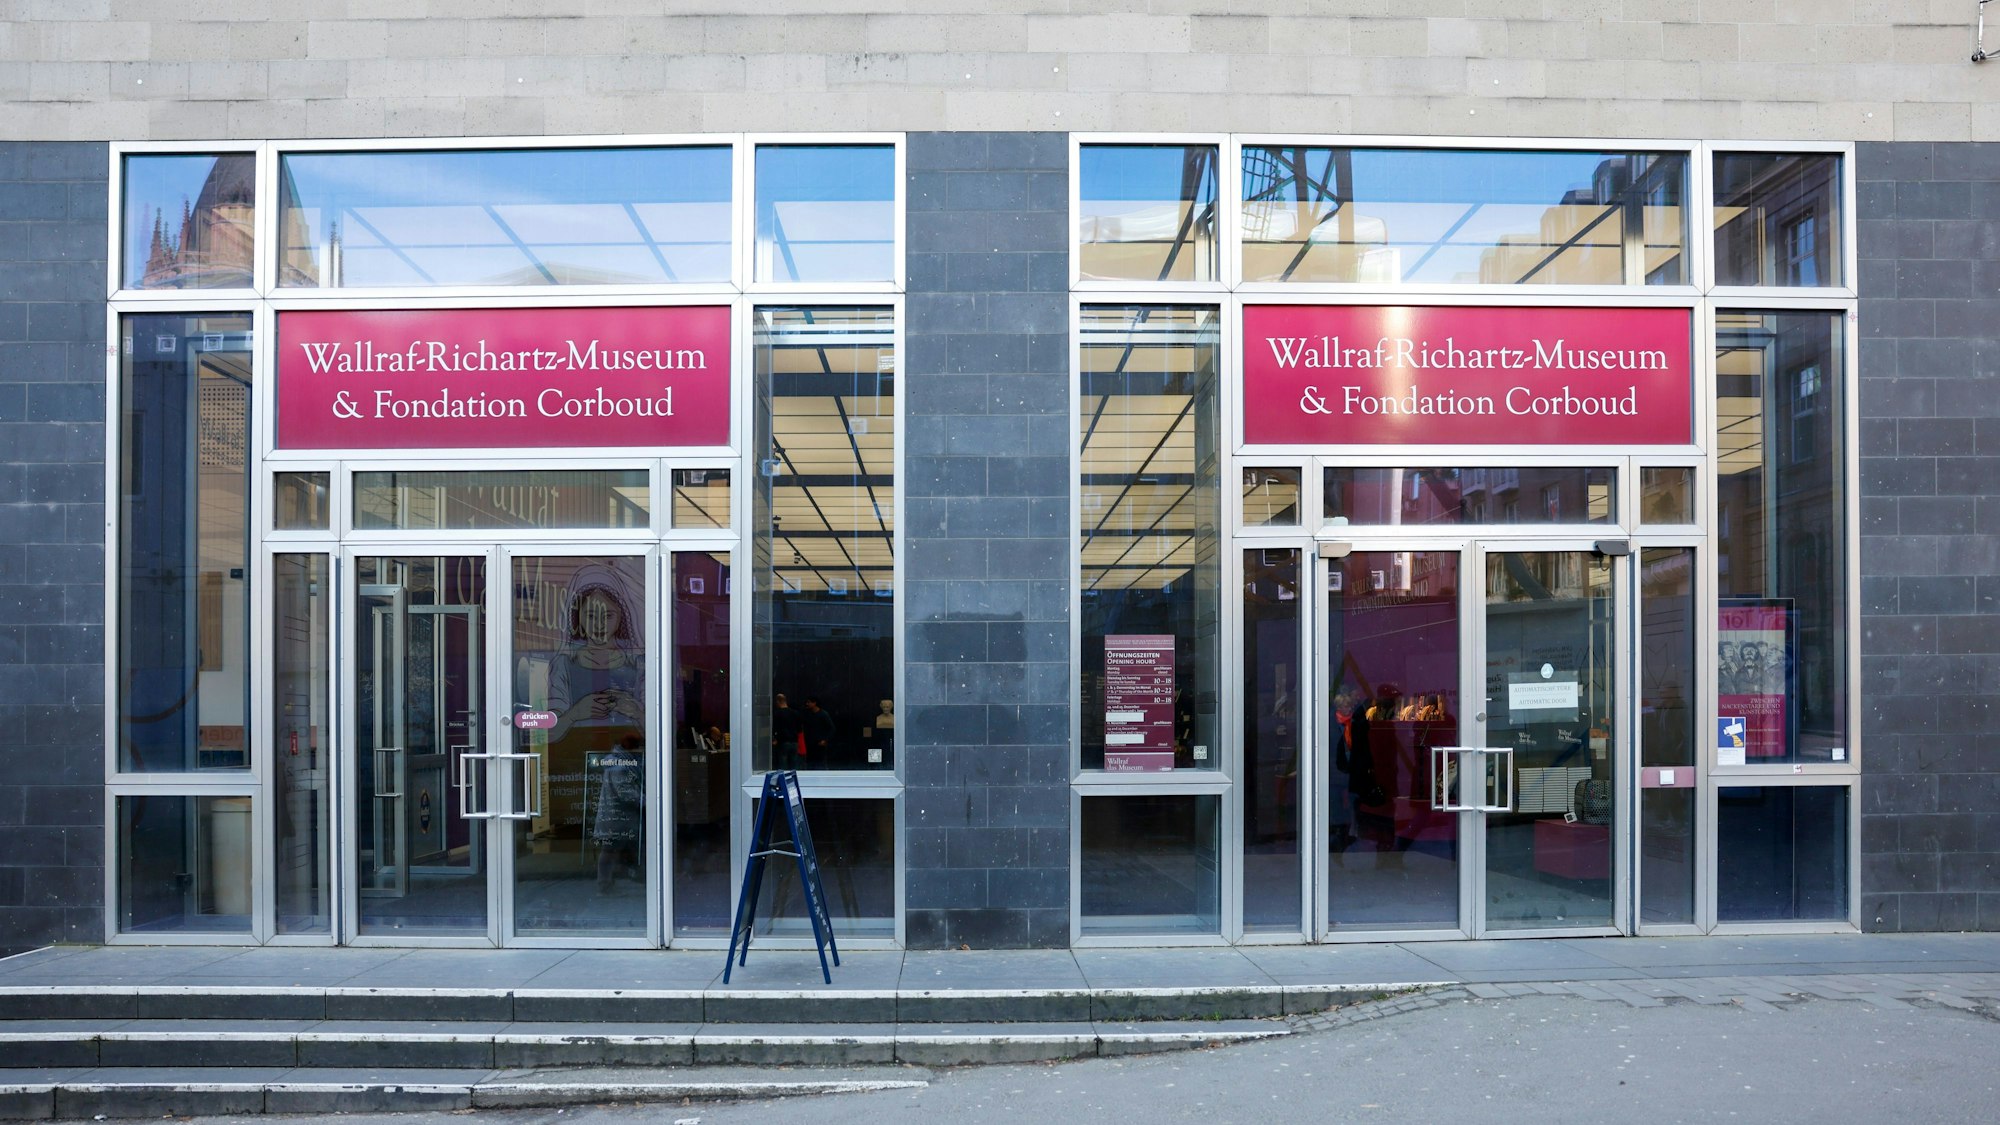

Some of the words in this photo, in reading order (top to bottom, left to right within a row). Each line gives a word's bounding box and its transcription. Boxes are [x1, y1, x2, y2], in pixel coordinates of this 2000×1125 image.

[300, 339, 707, 374] Wallraf-Richartz-Museum
[1266, 336, 1669, 370] Wallraf-Richartz-Museum
[332, 390, 364, 419] &
[373, 387, 528, 419] Fondation
[537, 385, 674, 417] Corboud
[1300, 386, 1332, 415] &
[1342, 386, 1496, 416] Fondation
[1505, 385, 1638, 416] Corboud
[517, 557, 609, 642] Museum
[522, 720, 538, 729] push
